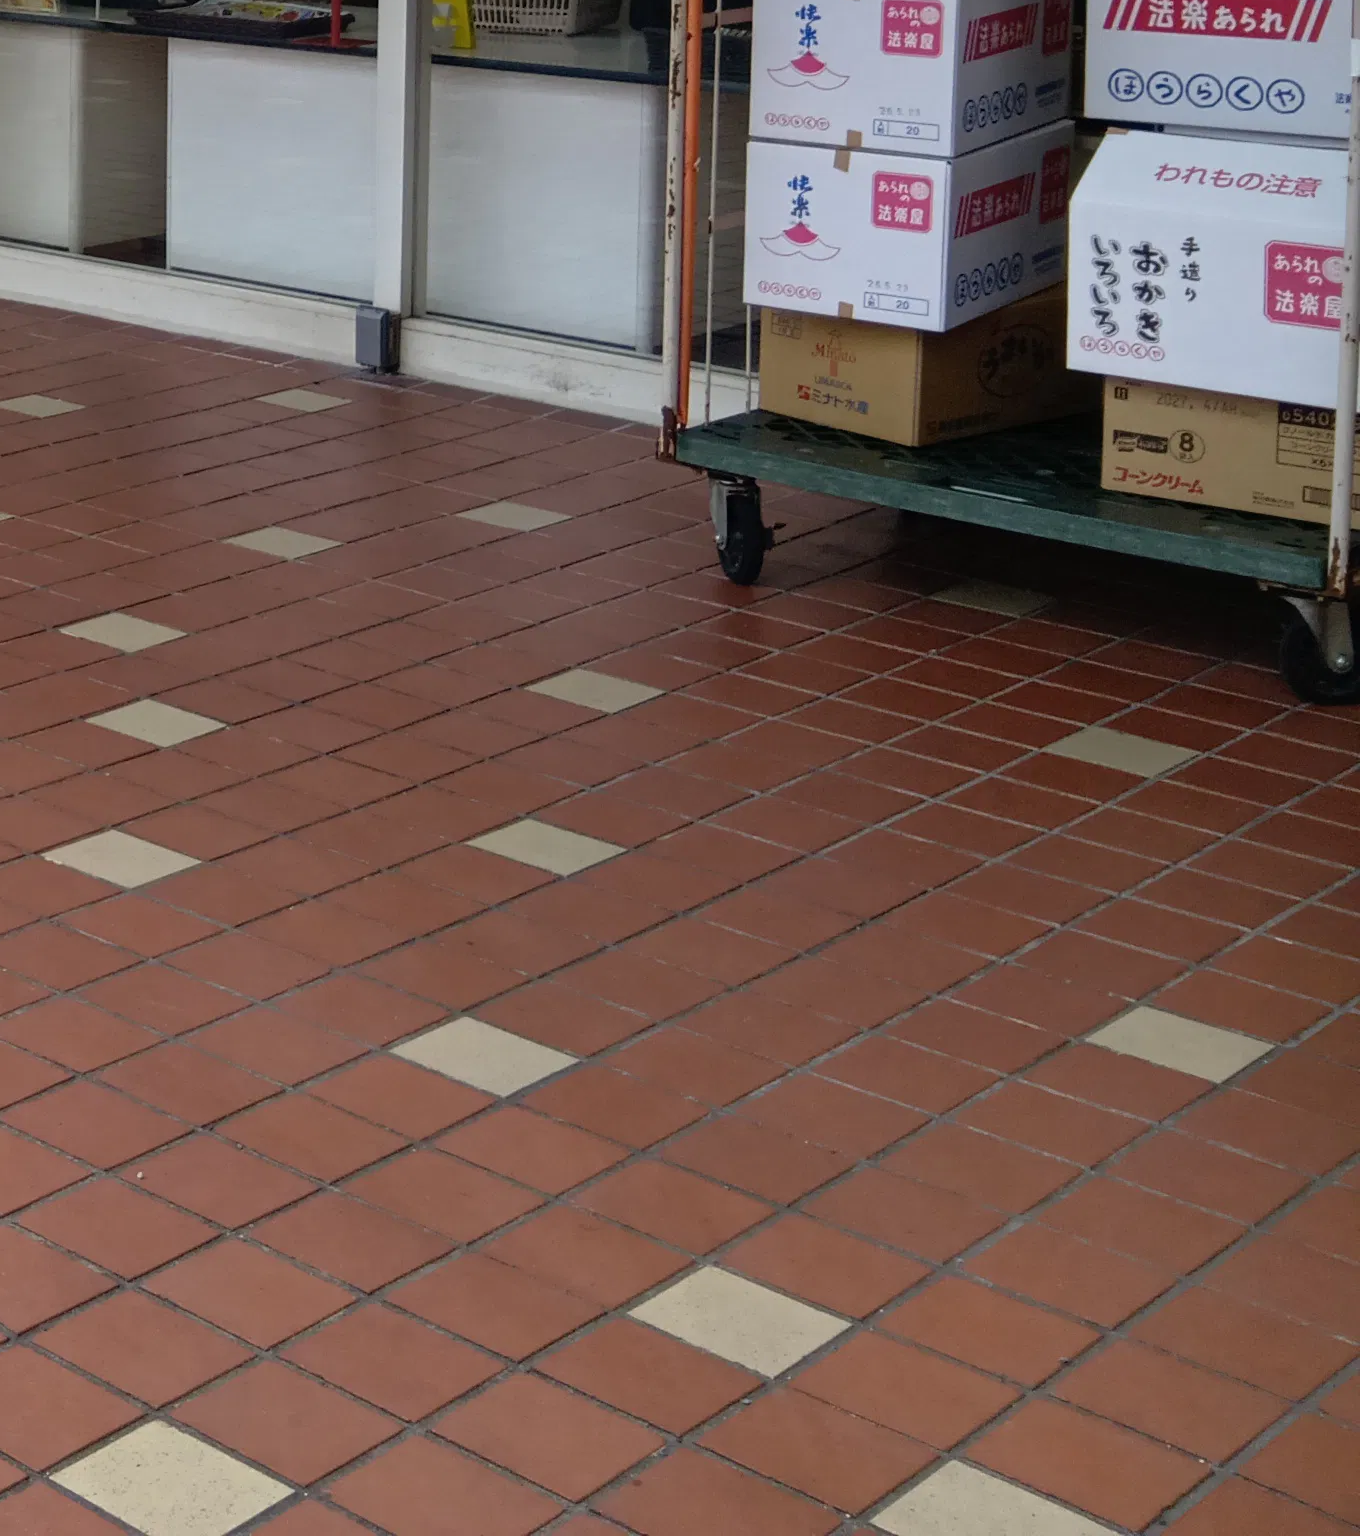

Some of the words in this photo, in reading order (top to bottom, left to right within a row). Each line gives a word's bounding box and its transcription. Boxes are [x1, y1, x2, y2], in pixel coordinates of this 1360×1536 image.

[887, 6, 920, 19] あられ
[888, 30, 935, 50] 法楽屋
[1110, 70, 1303, 112] ほうらくや
[905, 126, 920, 136] 20
[878, 181, 909, 194] あられ
[1154, 163, 1322, 199] われもの注意
[899, 194, 911, 202] の
[878, 204, 924, 225] 法楽屋
[1180, 237, 1201, 302] 手造り
[1274, 254, 1321, 274] あられ
[1091, 235, 1121, 336] いろいろ
[1307, 275, 1323, 286] の
[1131, 241, 1168, 343] おかき
[895, 300, 911, 310] 20
[1274, 289, 1343, 320] 法楽屋
[1179, 432, 1194, 452] 8
[1113, 467, 1204, 495] コーンクリーム
